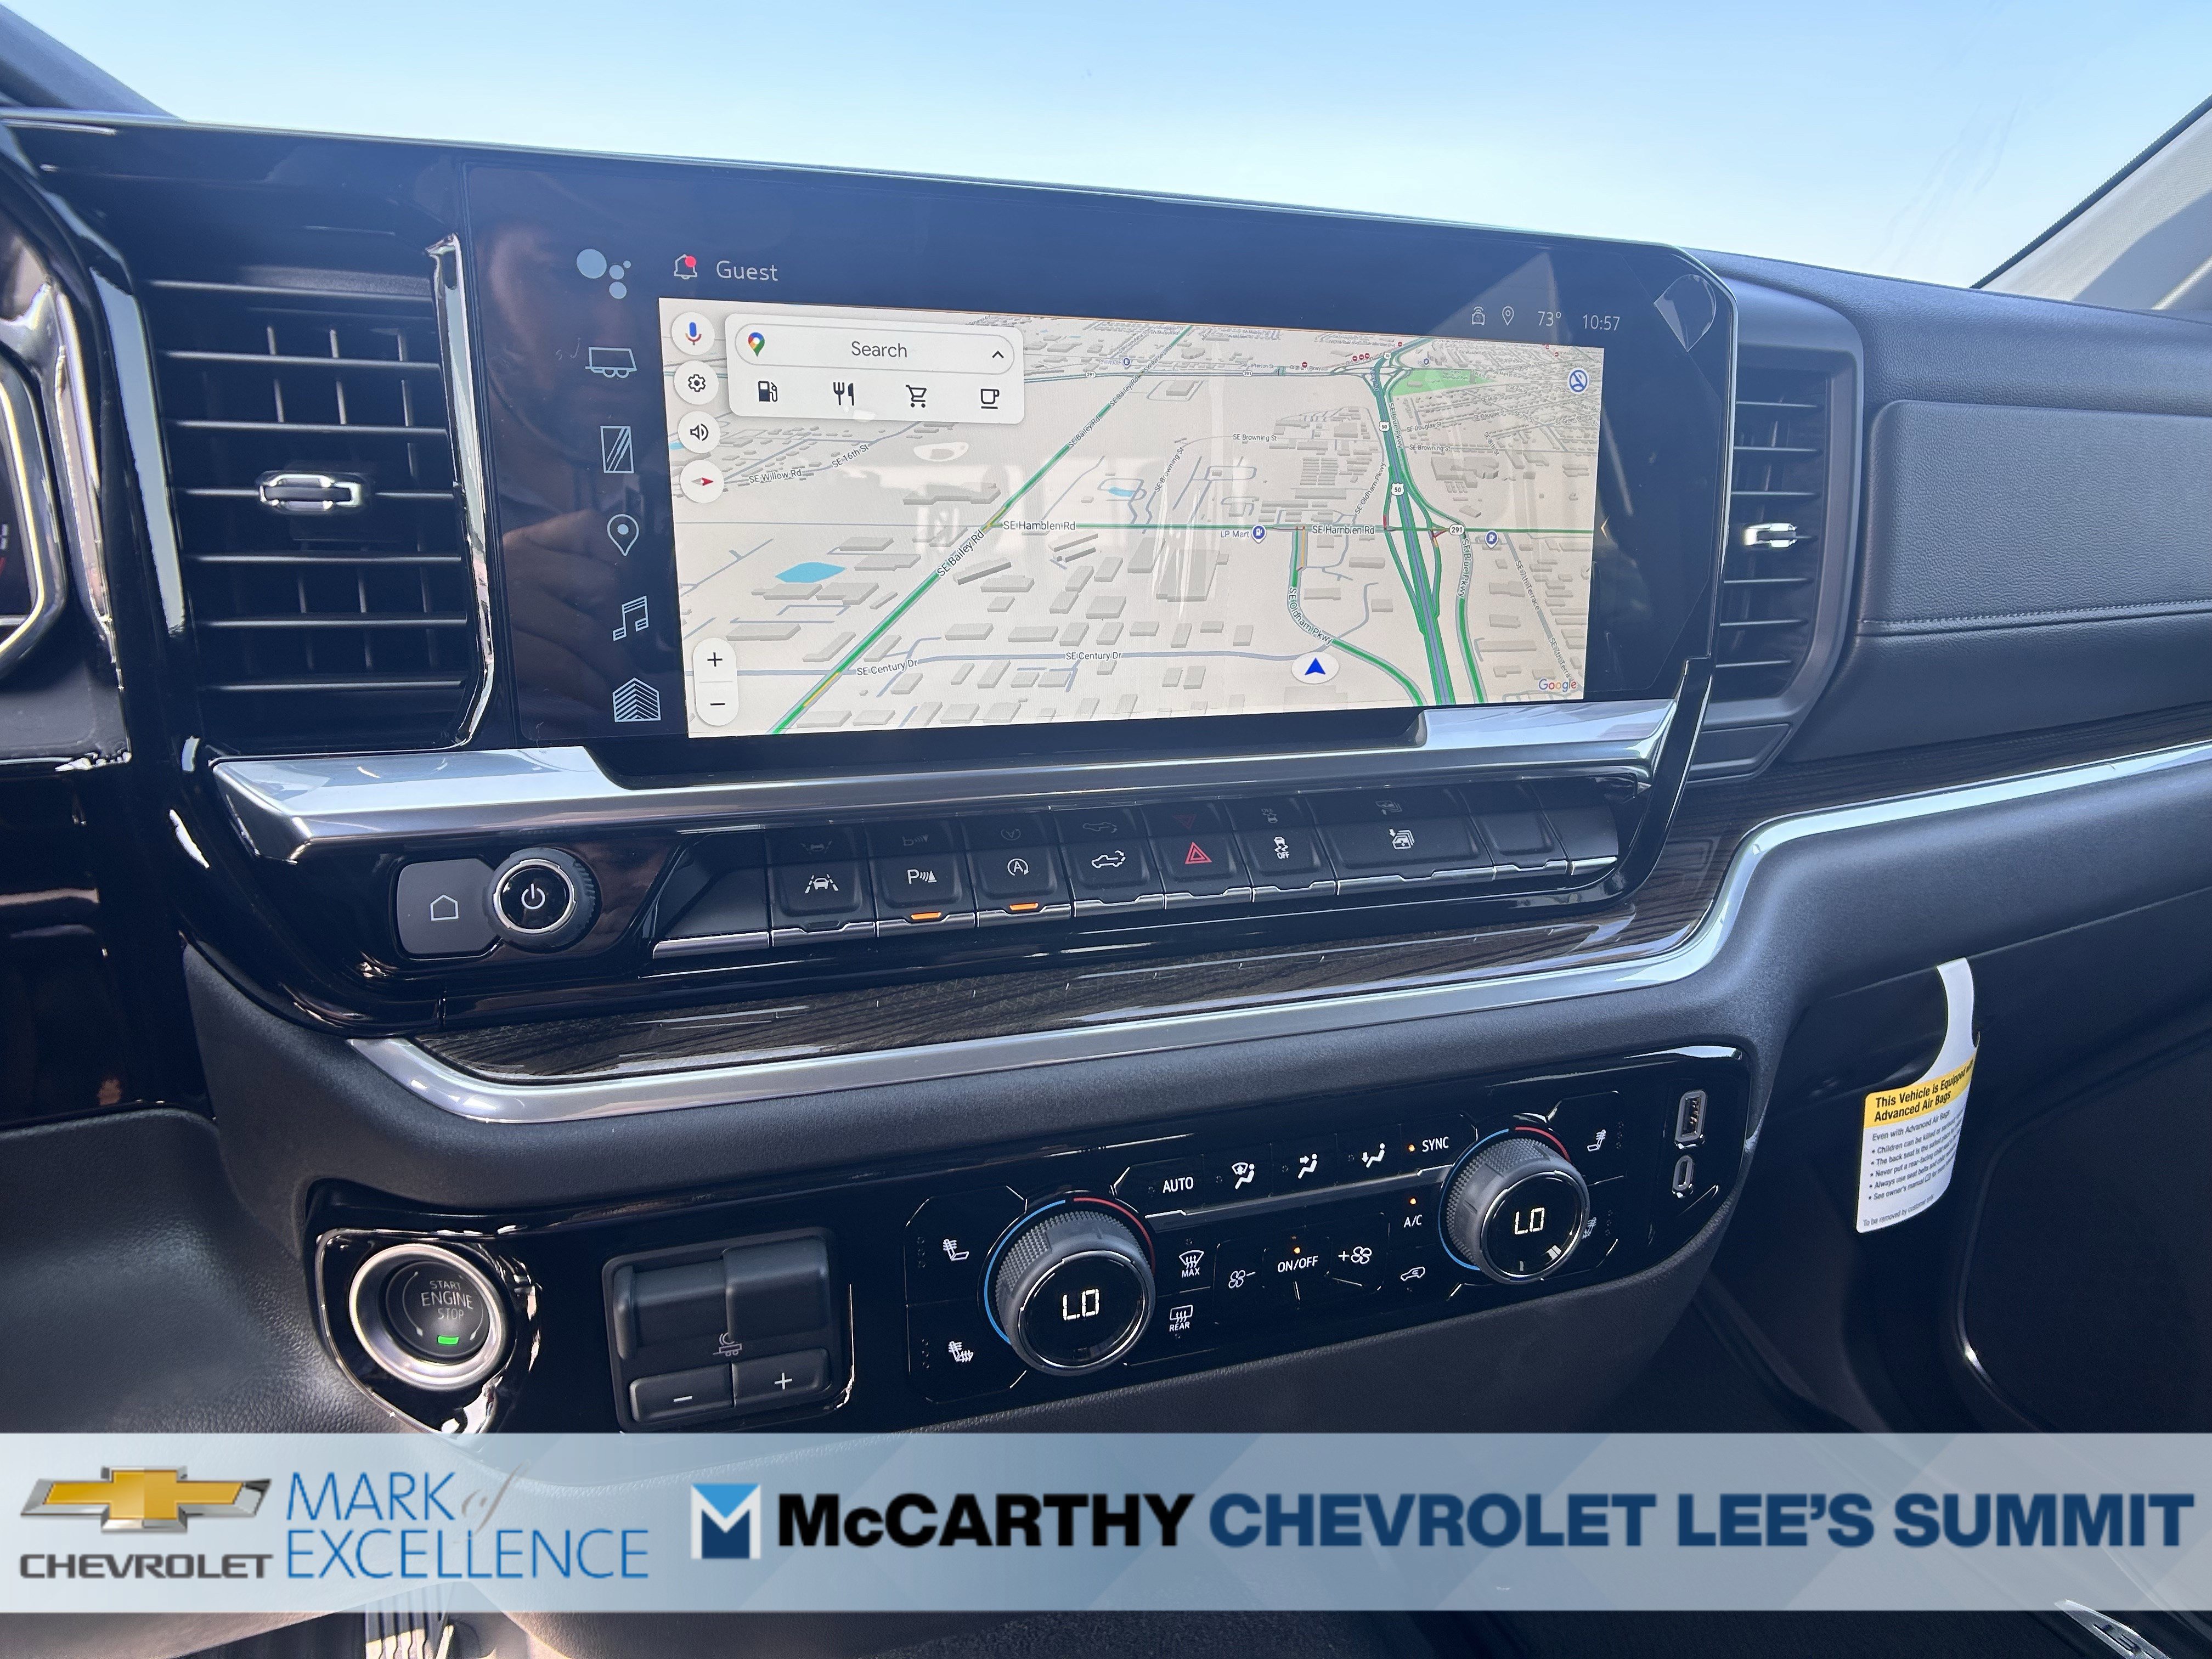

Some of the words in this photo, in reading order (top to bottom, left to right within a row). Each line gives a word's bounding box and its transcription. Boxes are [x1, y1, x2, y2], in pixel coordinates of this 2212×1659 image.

[716, 260, 778, 281] Guest
[1538, 311, 1561, 327] 73°
[1583, 314, 1620, 331] 10:57
[851, 341, 908, 358] Search
[1109, 398, 1118, 407] SE
[1116, 384, 1132, 400] Bailey
[1130, 375, 1139, 385] Rd
[1389, 403, 1395, 413] SE
[1391, 414, 1400, 431] Blue
[1068, 438, 1077, 448] SE
[1076, 424, 1093, 441] Bailey
[1091, 415, 1101, 426] Rd
[1242, 434, 1269, 442] Browning
[832, 458, 842, 469] SE
[843, 449, 860, 462] 16th
[860, 443, 870, 453] St
[749, 475, 760, 483] SE
[760, 472, 788, 482] Willow
[791, 469, 802, 477] Rd
[1154, 482, 1163, 493] SE
[1159, 454, 1181, 484] Browning
[1177, 447, 1184, 455] St
[1354, 504, 1363, 515] SE
[1359, 479, 1378, 505] Oldham
[1374, 462, 1386, 482] Pkwy
[1003, 521, 1016, 530] SE
[1019, 521, 1060, 530] Hamblen
[1064, 521, 1076, 531] Rd
[1312, 526, 1323, 534] SE
[1326, 526, 1362, 534] Hamblen
[1364, 526, 1375, 534] Rd
[937, 563, 951, 577] SE
[948, 543, 974, 566] Bailey
[970, 529, 985, 544] Rd
[1462, 539, 1470, 552] SE
[1463, 553, 1471, 572] Blue
[1289, 587, 1297, 600] SE
[1457, 575, 1469, 598] Pkwy
[1515, 561, 1524, 571] SE
[1526, 584, 1540, 611] Terrace
[1290, 602, 1312, 631] Oldham
[1312, 628, 1333, 645] Pkwy
[1549, 637, 1558, 648] SE
[1065, 652, 1077, 661] SE
[1078, 652, 1111, 662] Century
[857, 667, 870, 676] SE
[870, 662, 906, 675] Century
[907, 659, 918, 668] Dr
[1539, 679, 1577, 692] Google
[1277, 851, 1290, 860] OFF
[1876, 1096, 1896, 1108] This
[1899, 1087, 1930, 1104] Vehicle
[1932, 1083, 1939, 1094] is
[1940, 1066, 1966, 1091] Equipped
[1874, 1102, 1920, 1122] Advanced
[1922, 1098, 1933, 1111] Air
[1935, 1091, 1951, 1105] Bags
[1872, 1132, 1888, 1141] Even
[1890, 1128, 1904, 1138] with
[1905, 1118, 1932, 1135] Advanced
[1421, 1136, 1450, 1153] SYNC
[1877, 1143, 1903, 1154] Children
[1904, 1139, 1915, 1148] can
[1875, 1167, 1893, 1177] Never
[1893, 1164, 1903, 1174] put
[1908, 1153, 1934, 1168] rear-facing
[1876, 1158, 1887, 1166] The
[1888, 1153, 1903, 1163] back
[1904, 1150, 1915, 1159] seat
[1163, 1176, 1194, 1193] AUTO
[1874, 1178, 1895, 1189] Always
[1906, 1171, 1918, 1180] seat
[1918, 1165, 1929, 1175] belts
[1874, 1192, 1885, 1200] See
[1886, 1185, 1907, 1198] owner's
[1907, 1177, 1925, 1190] manual
[1403, 1214, 1422, 1228] A/C
[1513, 1206, 1546, 1236] LO
[1879, 1210, 1901, 1223] removed
[1901, 1208, 1908, 1216] by
[1181, 1266, 1200, 1278] MAX
[1277, 1254, 1319, 1273] ON/OFF
[429, 1280, 461, 1291] START
[421, 1290, 473, 1310] ENGINE
[1062, 1288, 1100, 1321] LO
[437, 1308, 464, 1321] STOP
[1169, 1321, 1190, 1332] REAR
